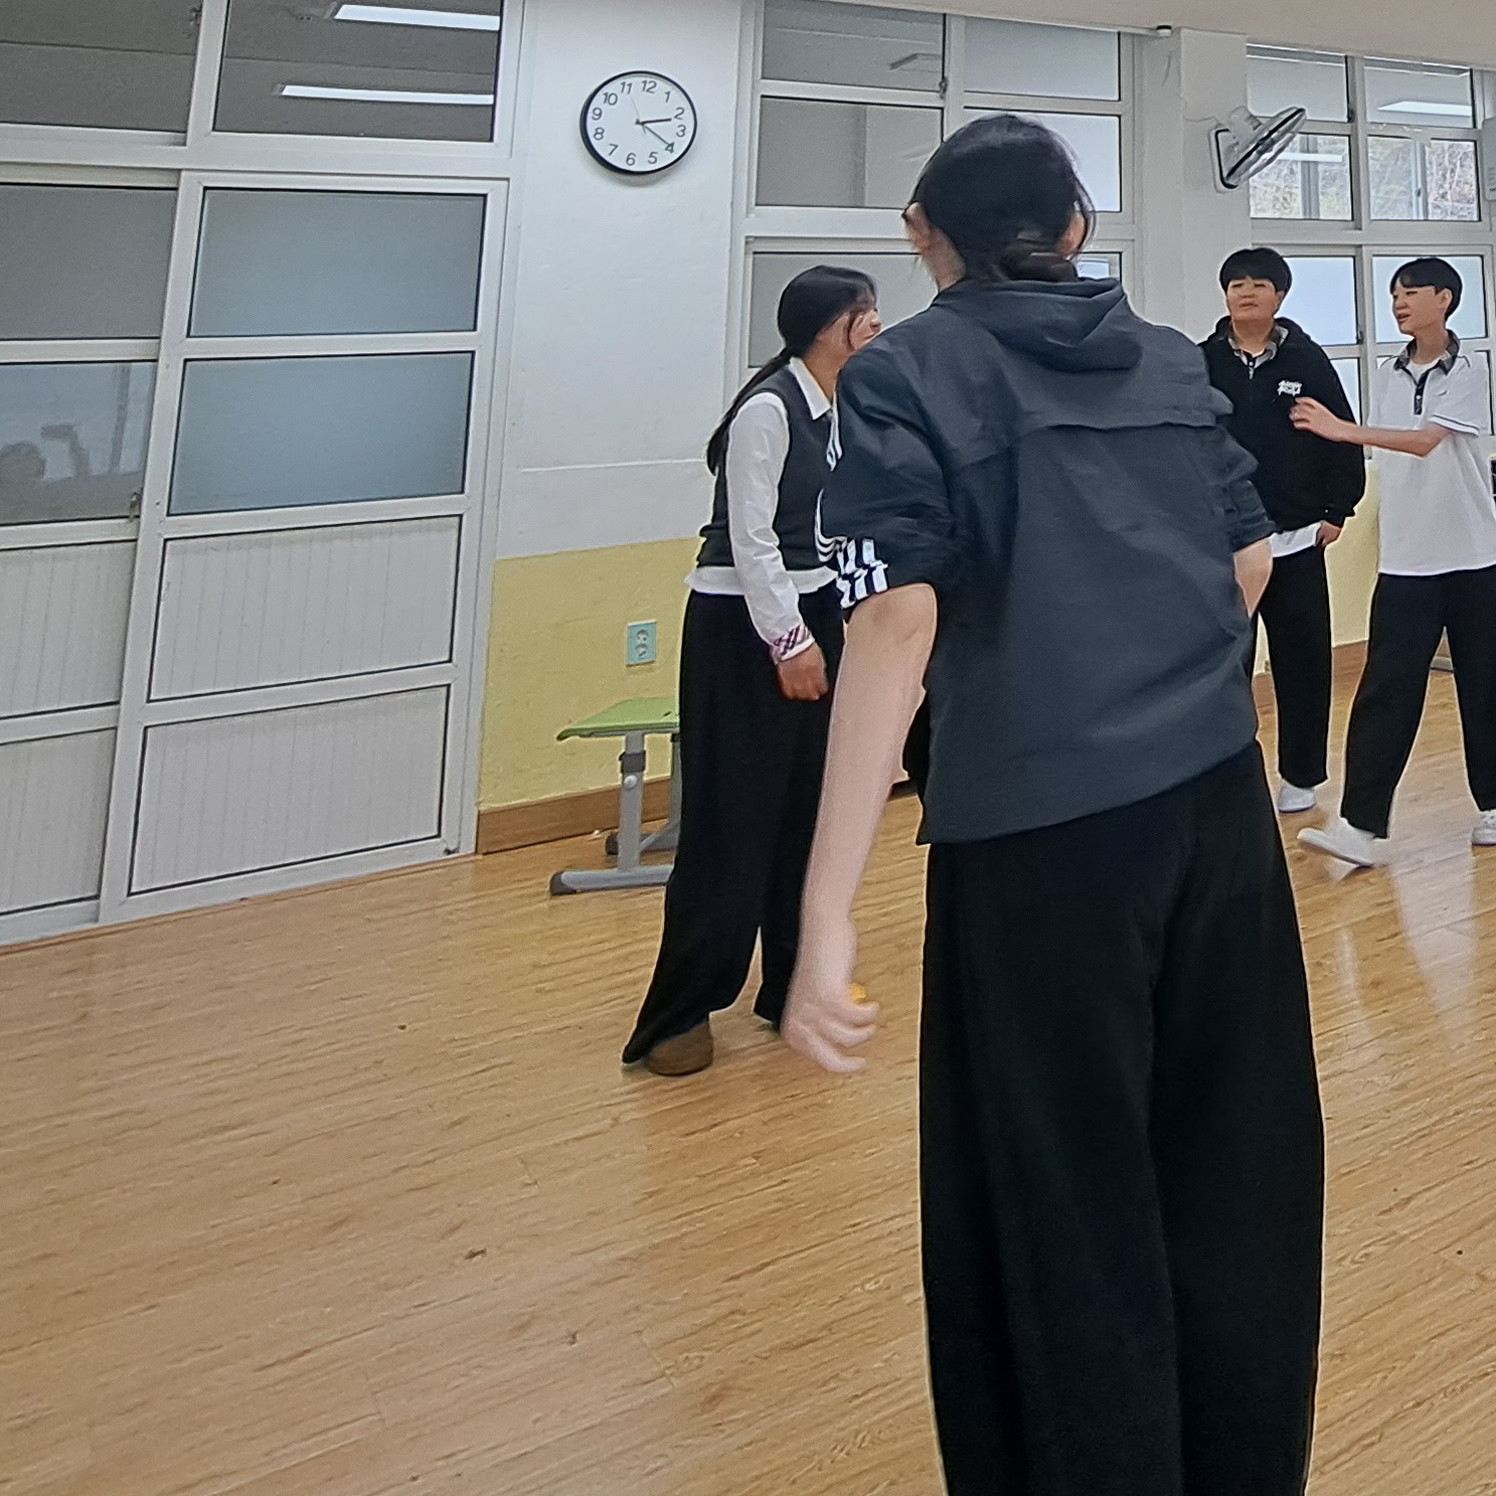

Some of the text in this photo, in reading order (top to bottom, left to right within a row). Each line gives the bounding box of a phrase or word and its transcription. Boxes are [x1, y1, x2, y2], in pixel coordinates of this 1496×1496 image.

[620, 81, 632, 94] 11
[641, 80, 657, 93] 12
[602, 92, 618, 106] 10
[664, 91, 671, 103] 1
[591, 107, 603, 121] 9
[674, 107, 685, 120] 2
[593, 127, 605, 141] 8
[676, 124, 686, 138] 3
[608, 143, 619, 156] 7
[664, 142, 675, 154] 4
[625, 152, 637, 166] 6
[647, 151, 658, 164] 5
